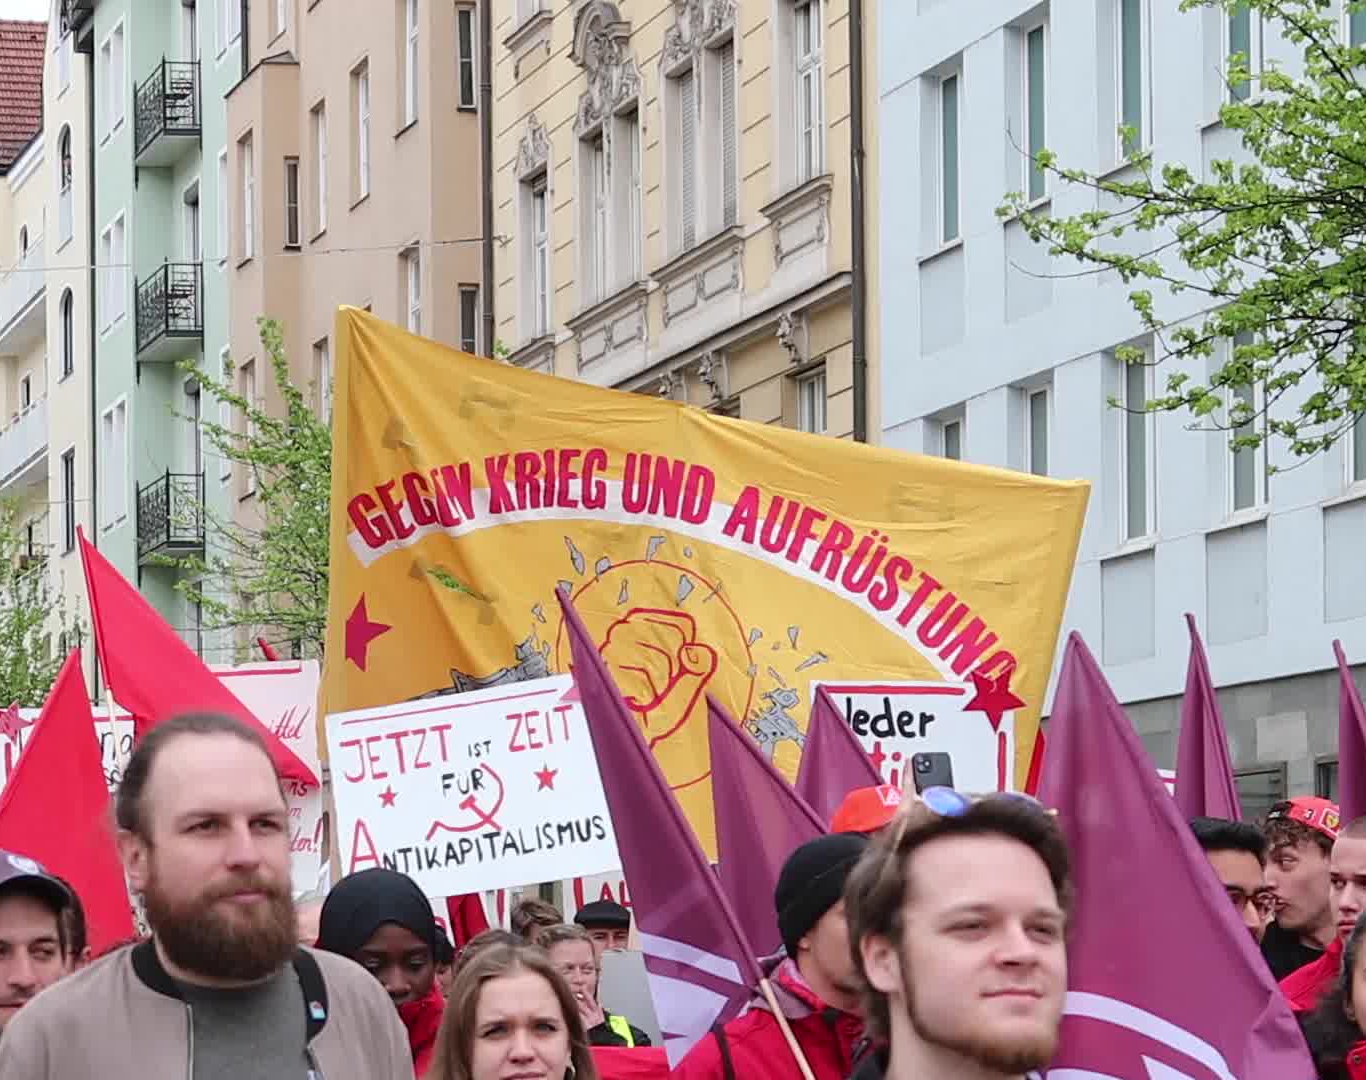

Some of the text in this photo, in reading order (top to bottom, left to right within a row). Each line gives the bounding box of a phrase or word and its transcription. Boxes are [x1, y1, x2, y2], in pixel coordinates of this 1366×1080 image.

[485, 448, 609, 514] KRIEG
[621, 452, 716, 525] UND
[339, 704, 573, 783] JETZT IST ZEIT
[349, 815, 606, 874] ANTIKAPITALISMUS
